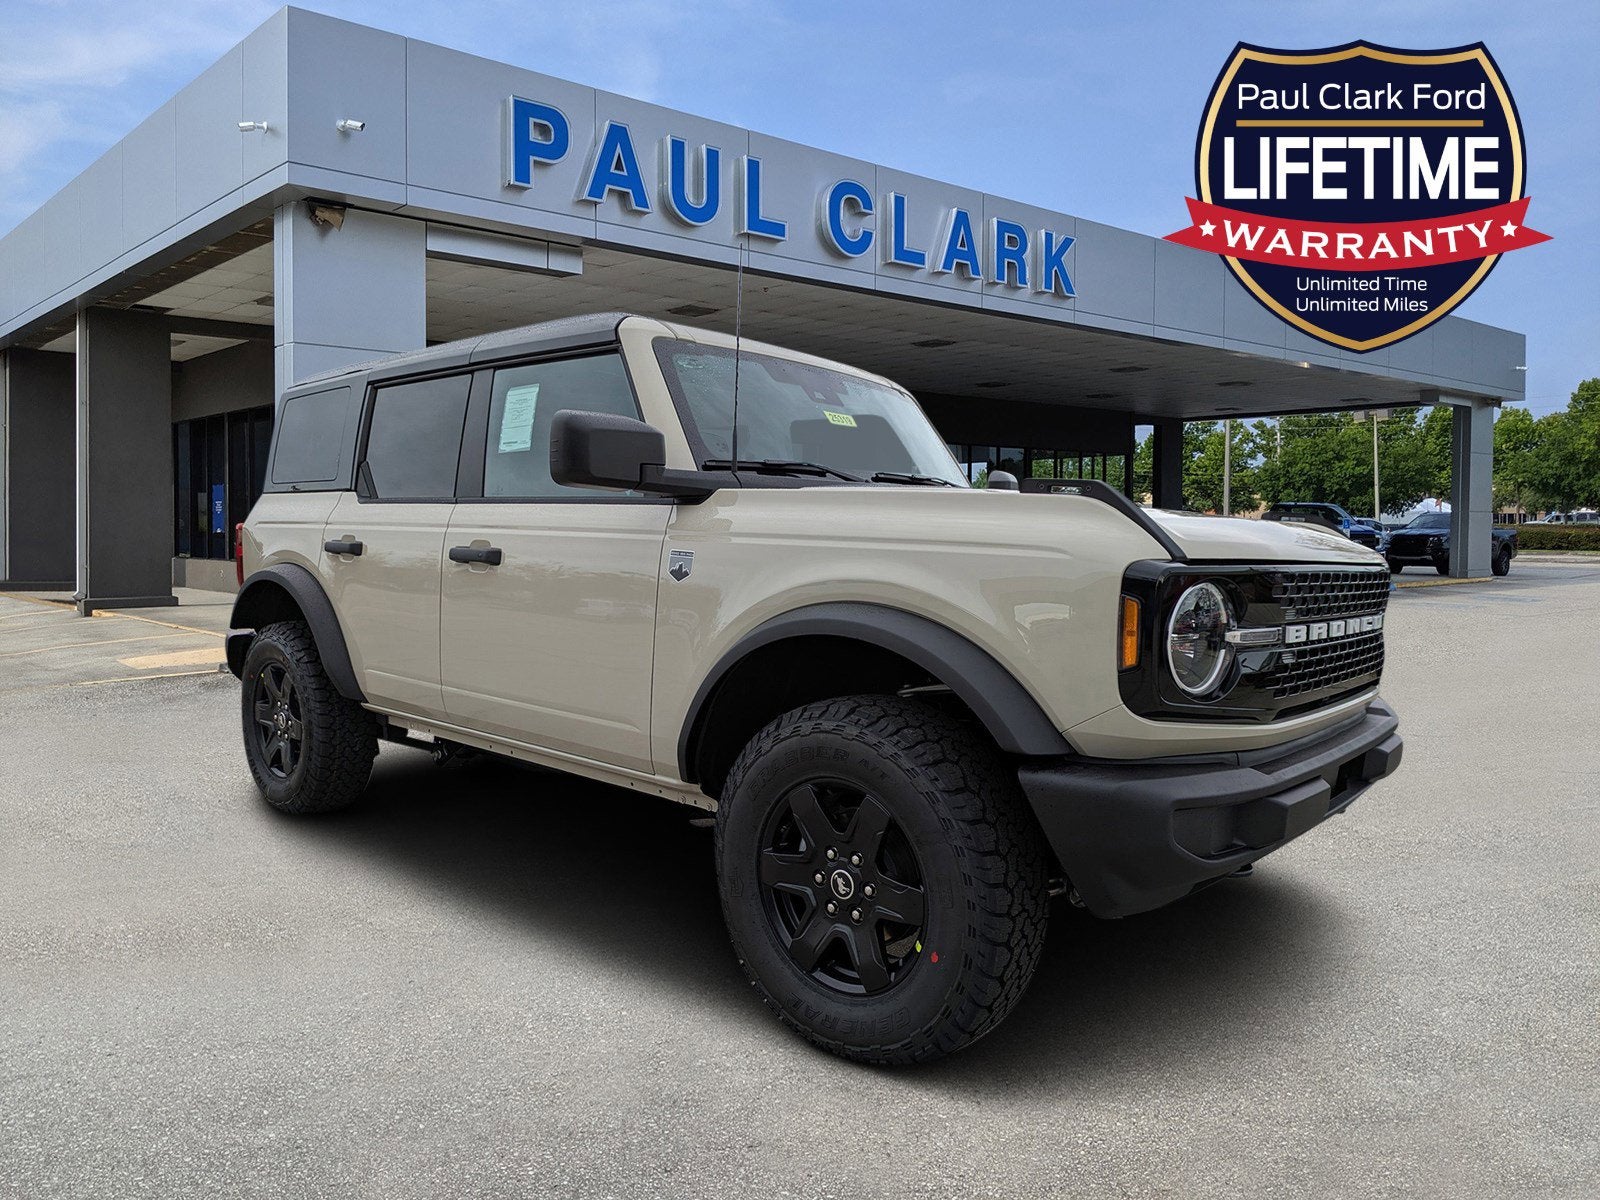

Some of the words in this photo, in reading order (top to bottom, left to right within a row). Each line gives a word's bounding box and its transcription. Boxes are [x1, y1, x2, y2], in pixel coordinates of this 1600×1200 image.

[507, 94, 788, 241] PAUL
[822, 178, 1077, 298] CLARK
[1285, 614, 1383, 644] BRONCO
